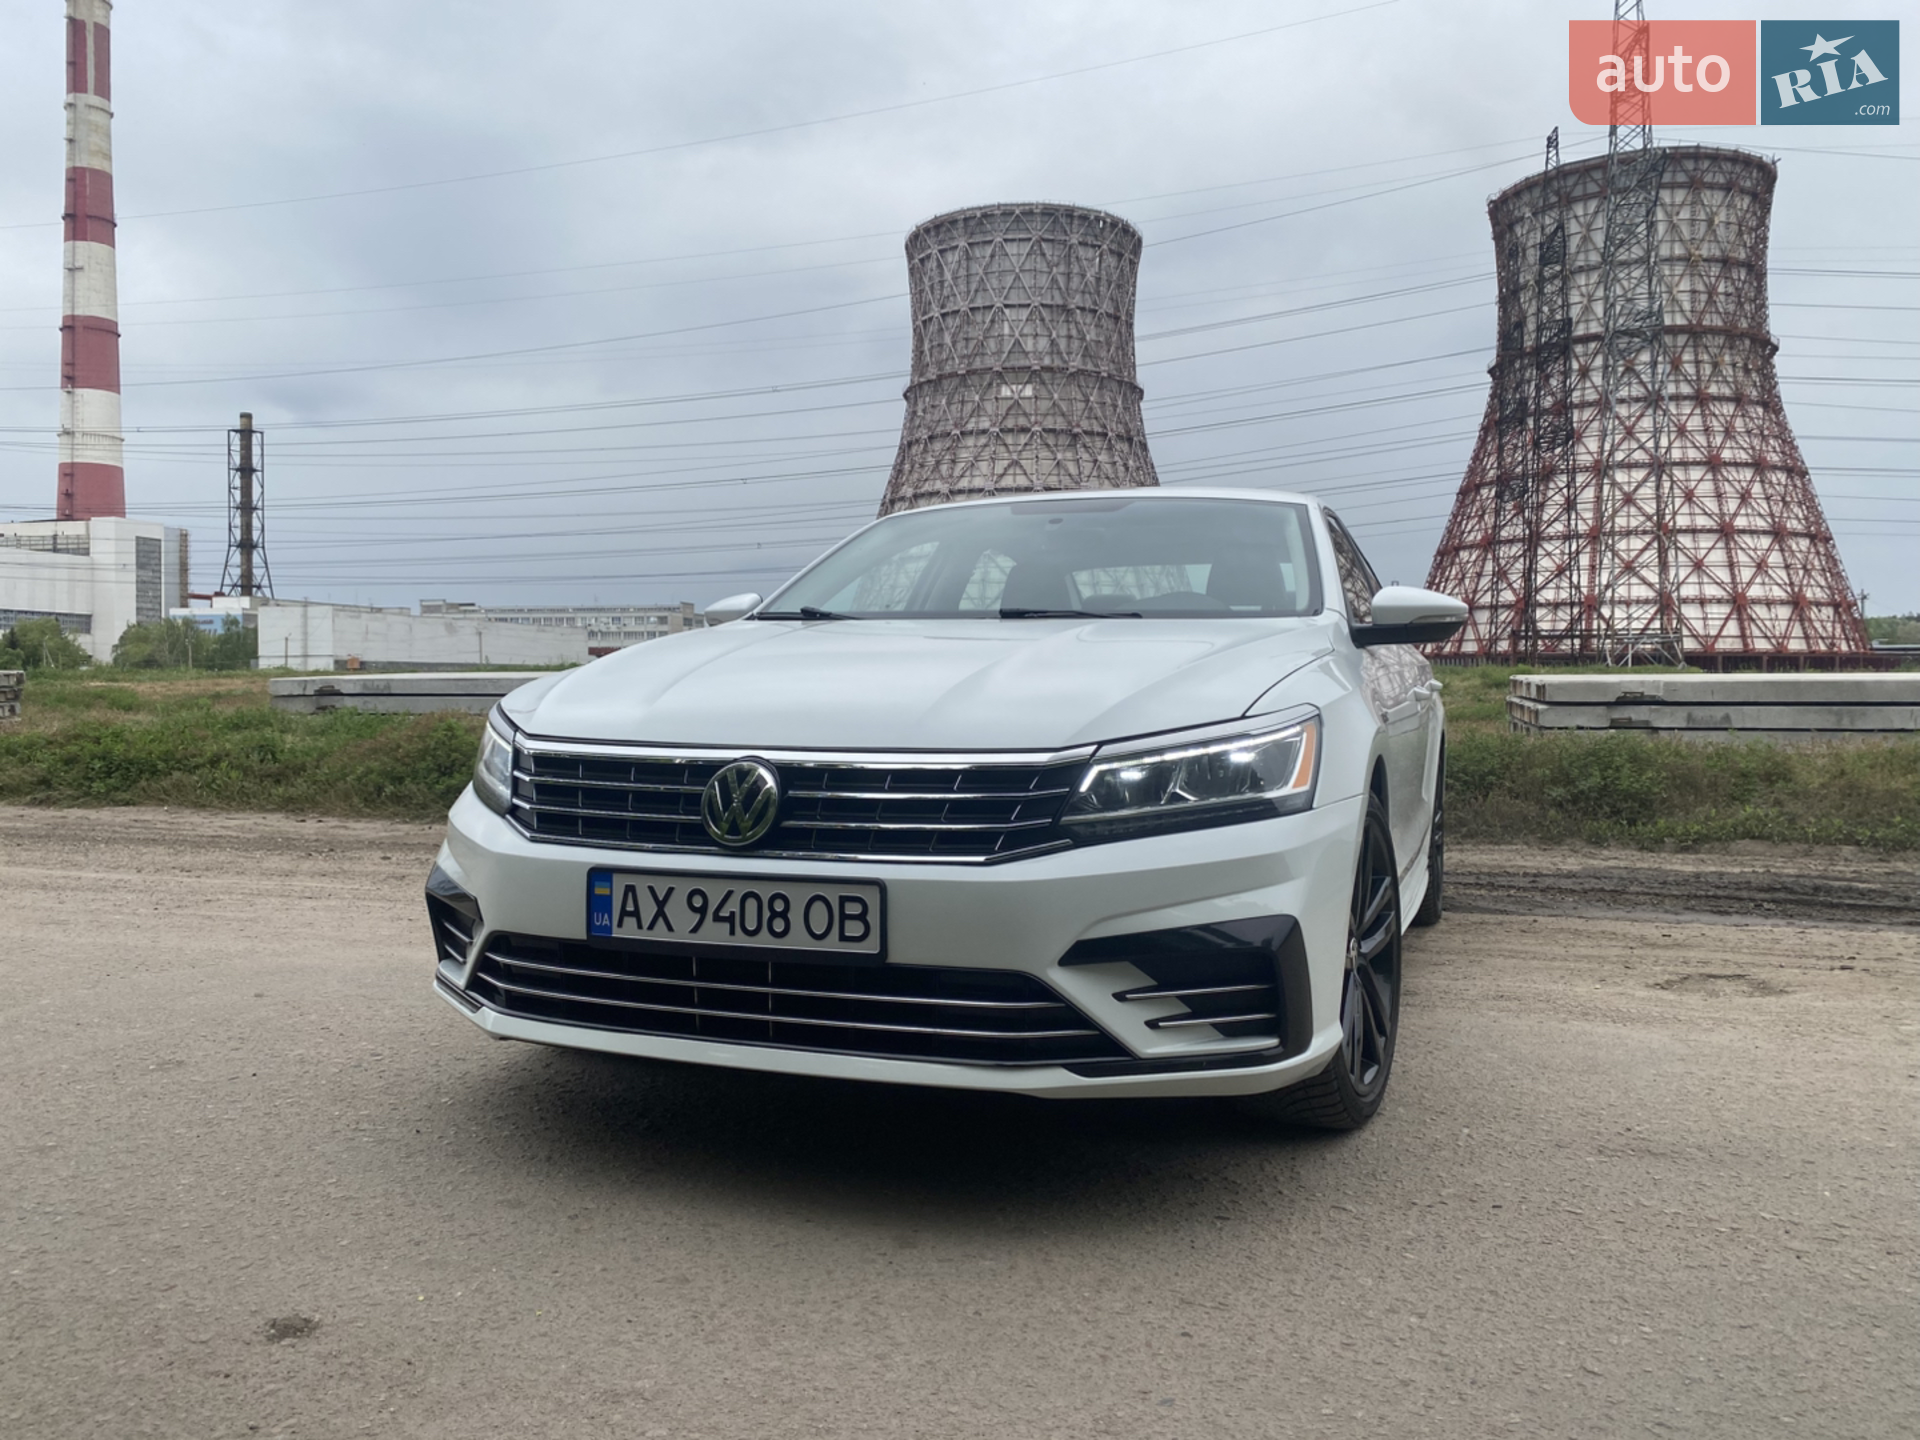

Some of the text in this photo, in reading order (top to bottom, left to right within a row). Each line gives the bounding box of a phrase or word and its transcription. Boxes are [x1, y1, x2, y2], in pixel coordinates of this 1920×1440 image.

[594, 911, 611, 927] UA
[616, 883, 871, 943] AX 9408 OB
